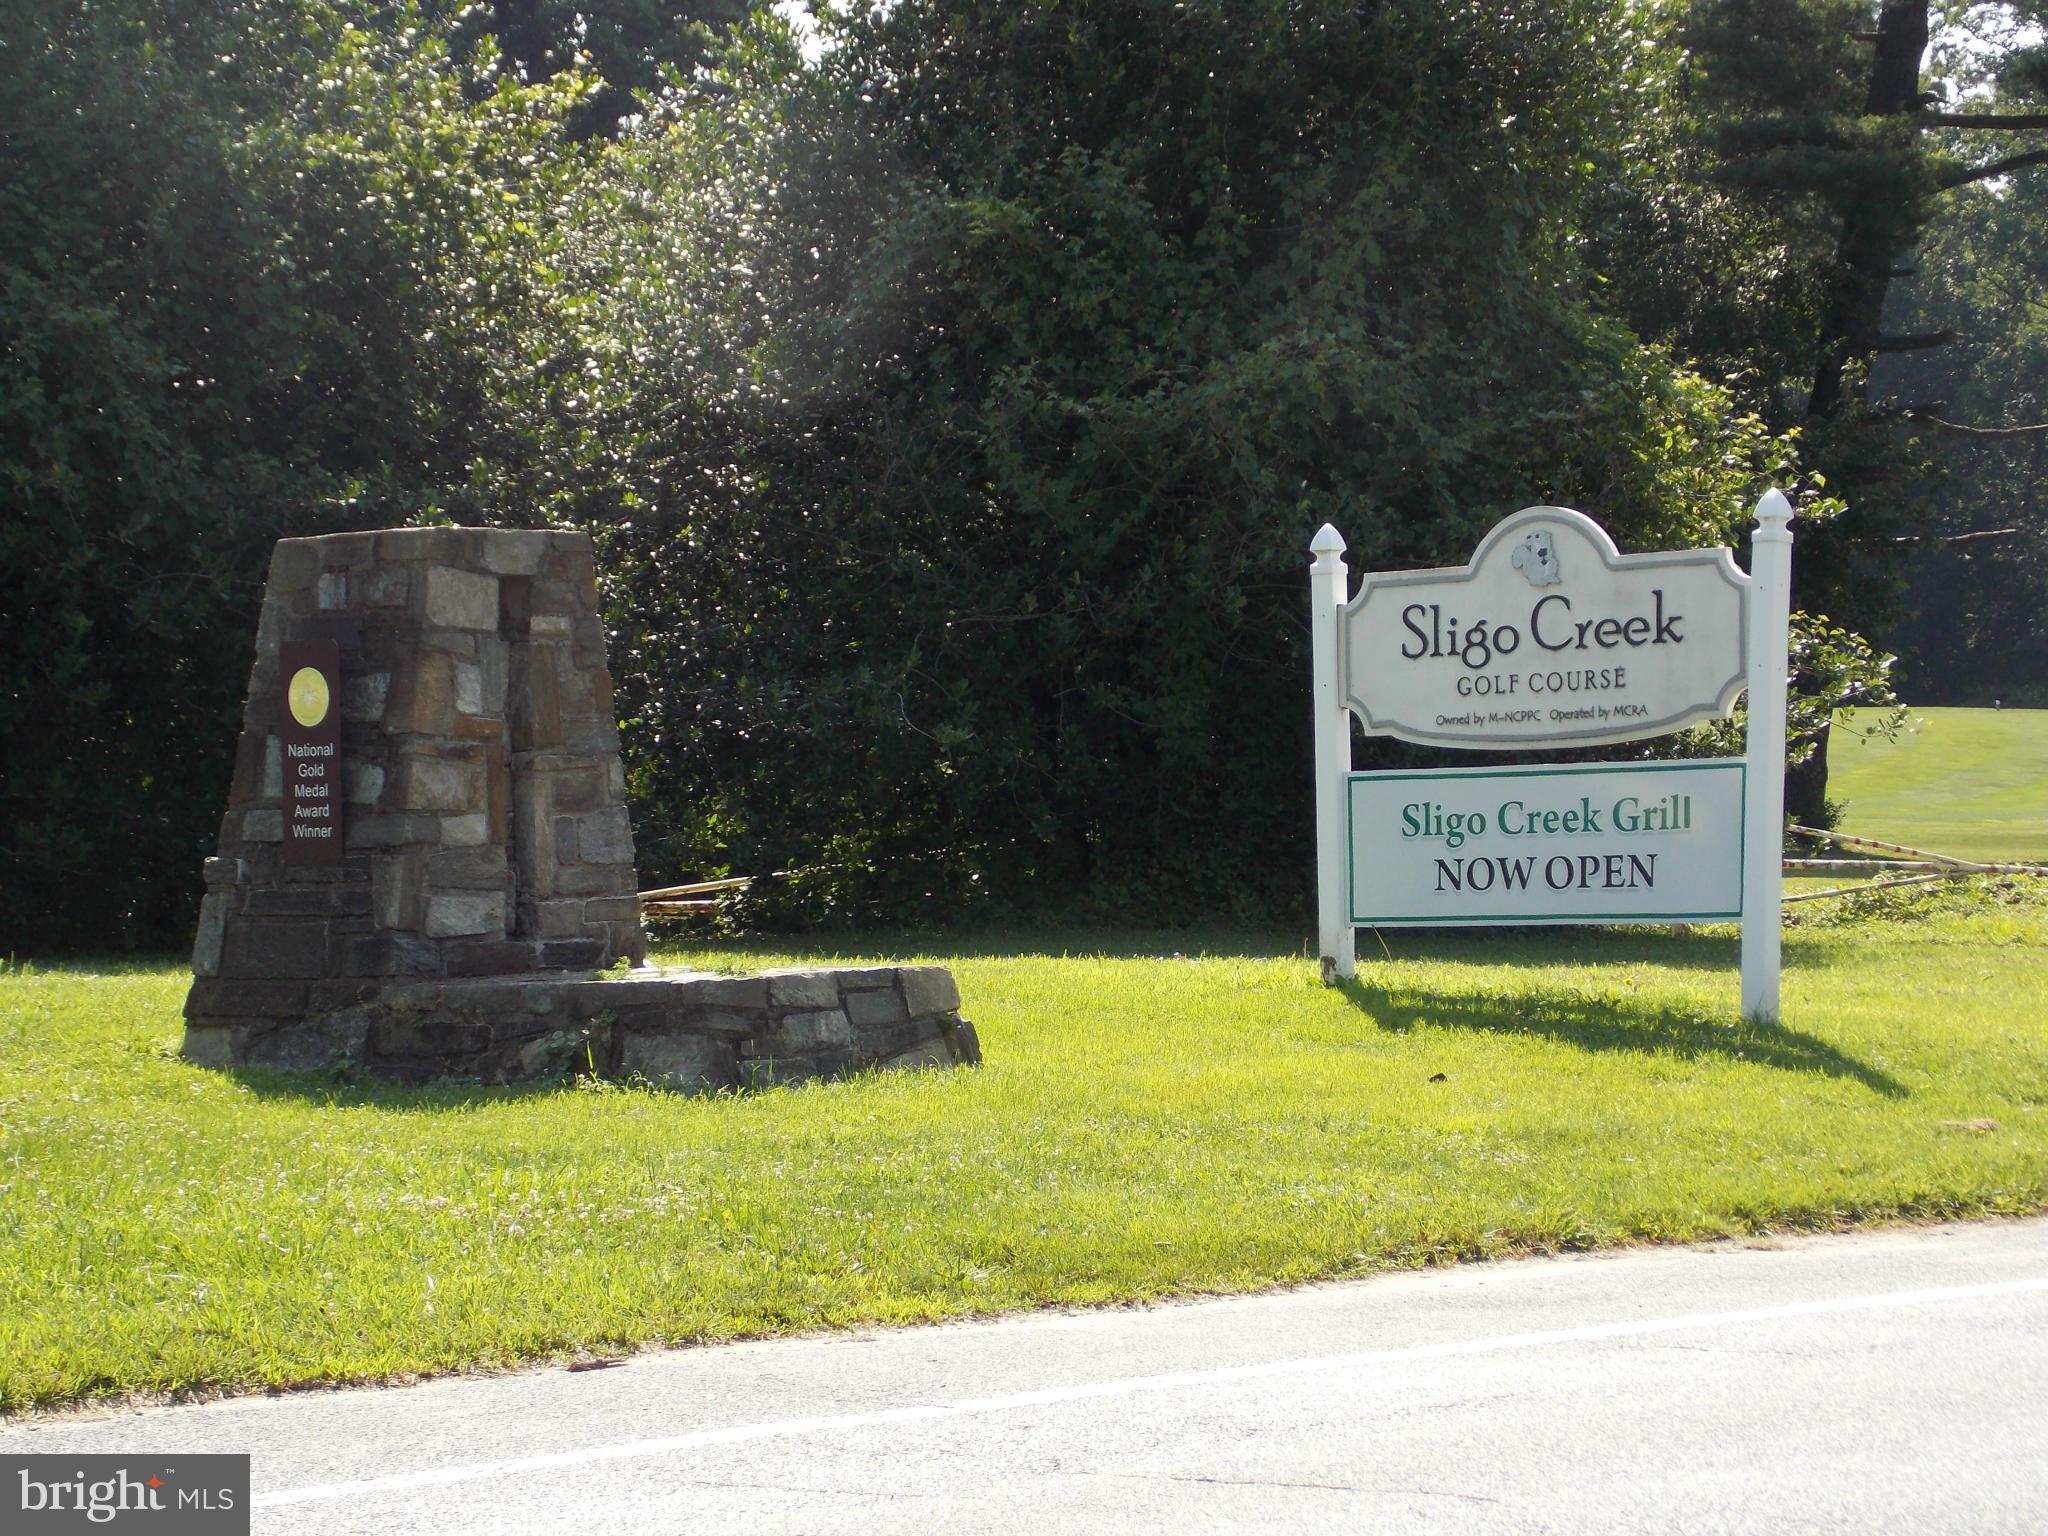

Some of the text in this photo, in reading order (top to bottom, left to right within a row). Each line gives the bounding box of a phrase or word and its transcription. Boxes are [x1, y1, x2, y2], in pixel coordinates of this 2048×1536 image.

[1401, 590, 1684, 669] Sligo Creek
[1457, 667, 1626, 696] GOLF COURSE
[1436, 713, 1470, 726] Owned
[1474, 713, 1485, 727] by
[1550, 708, 1595, 721] Operated
[1598, 706, 1610, 721] by
[1613, 704, 1648, 717] MCRA
[288, 743, 333, 757] National
[298, 763, 324, 777] Gold
[295, 784, 328, 797] Medal
[294, 804, 330, 818] Award
[1402, 794, 1692, 849] Sligo Creek Grill
[292, 825, 332, 838] Winner
[1434, 854, 1658, 891] NOW OPEN
